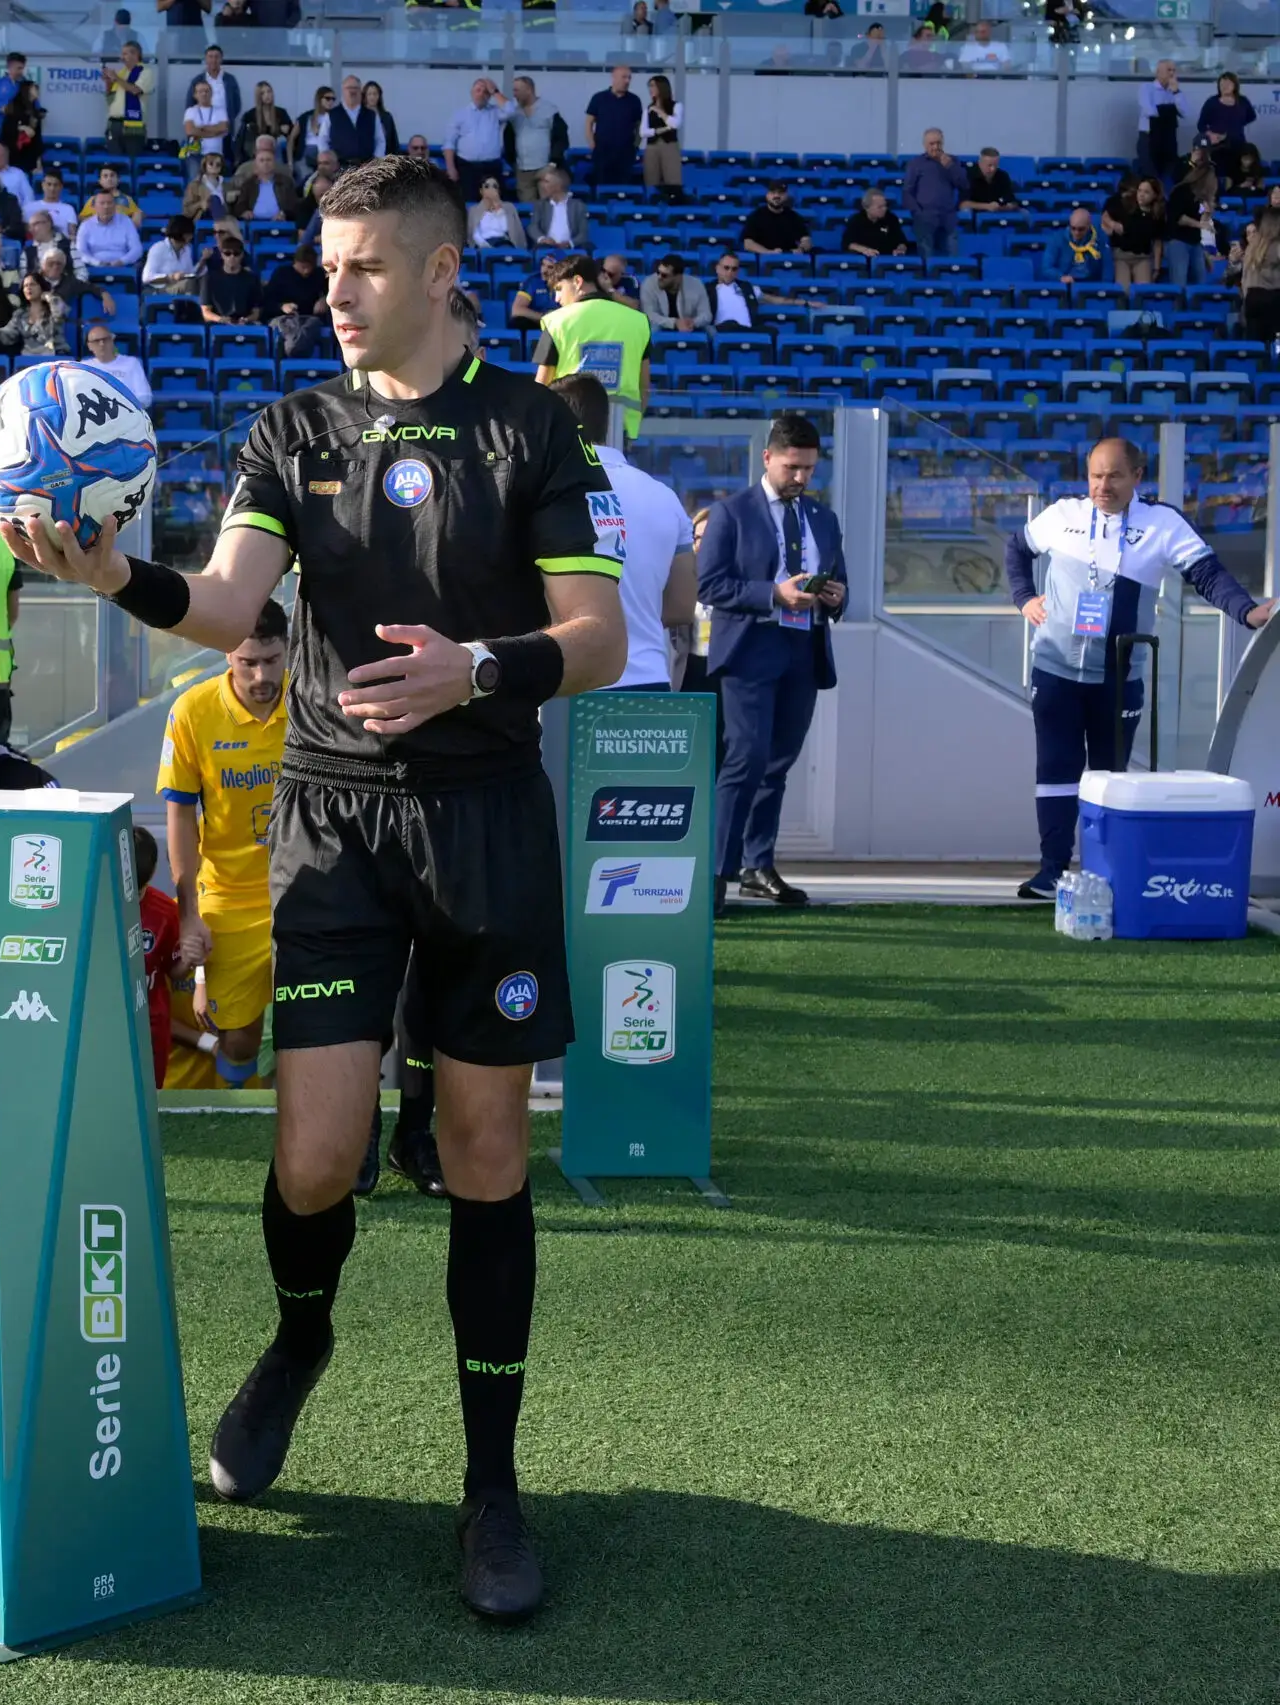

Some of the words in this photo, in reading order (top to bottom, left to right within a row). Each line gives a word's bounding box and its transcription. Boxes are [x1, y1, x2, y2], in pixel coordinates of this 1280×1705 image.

[47, 68, 104, 80] TRIBUN
[47, 83, 105, 93] CENTRAL
[362, 426, 456, 443] GIVOVA
[394, 472, 424, 489] AIA
[595, 519, 625, 527] INSUR
[595, 729, 631, 738] BANCA
[633, 729, 688, 738] POPOLARE
[213, 740, 248, 750] Zeus
[595, 740, 688, 754] FRUSINATE
[221, 761, 281, 790] MeglioB
[616, 800, 686, 817] Zeus
[640, 818, 659, 826] gli
[24, 875, 47, 883] Serie
[15, 885, 55, 900] BKT
[633, 888, 684, 897] TURRIZIANI
[1, 938, 63, 961] BKT
[275, 979, 355, 1002] GIVOVA
[505, 983, 532, 1003] AIA
[623, 1016, 655, 1028] Serie
[611, 1031, 667, 1050] BKT
[84, 1208, 122, 1338] BKT
[89, 1353, 121, 1480] Serie
[93, 1573, 115, 1587] GRA
[93, 1584, 115, 1598] FOX
